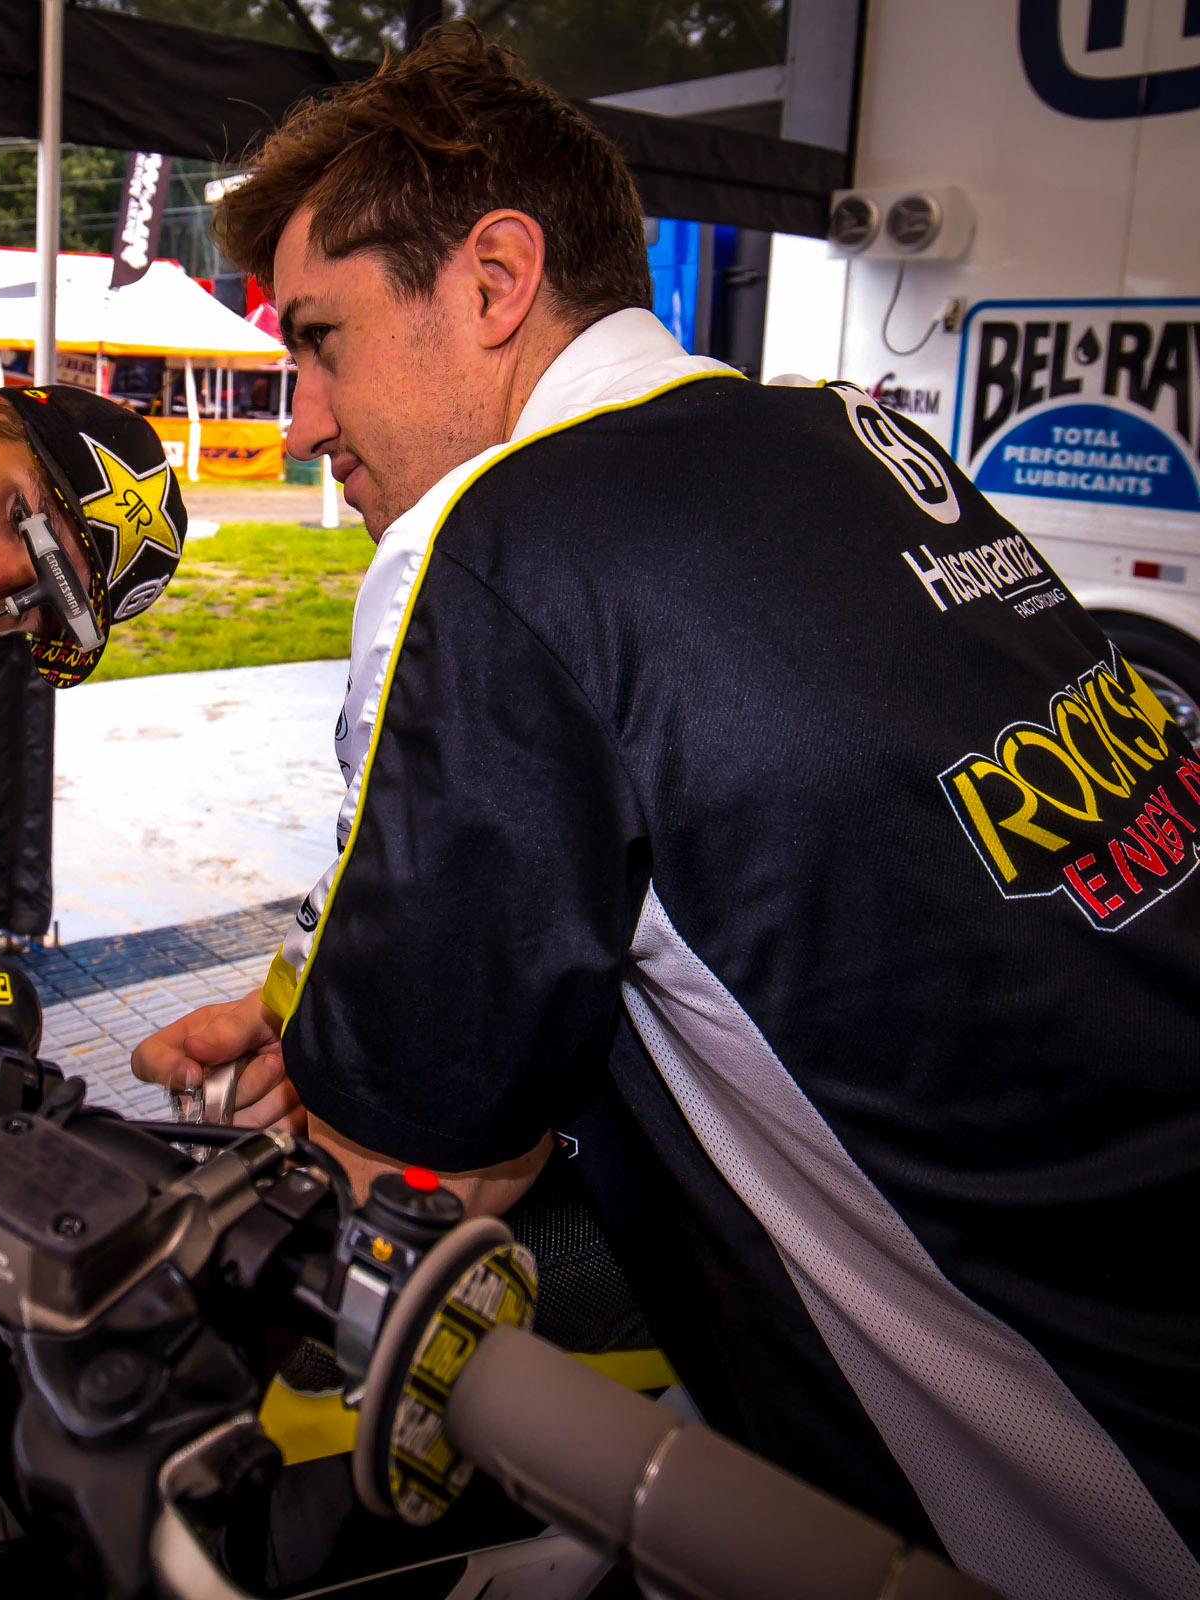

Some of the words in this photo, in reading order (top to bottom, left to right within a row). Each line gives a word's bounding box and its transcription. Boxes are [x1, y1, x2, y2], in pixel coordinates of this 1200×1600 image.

[1051, 426, 1121, 448] TOTAL
[1003, 445, 1171, 475] PERFORMANCE
[1015, 468, 1152, 497] LUBRICANTS
[46, 552, 82, 617] CRAFTSMAN
